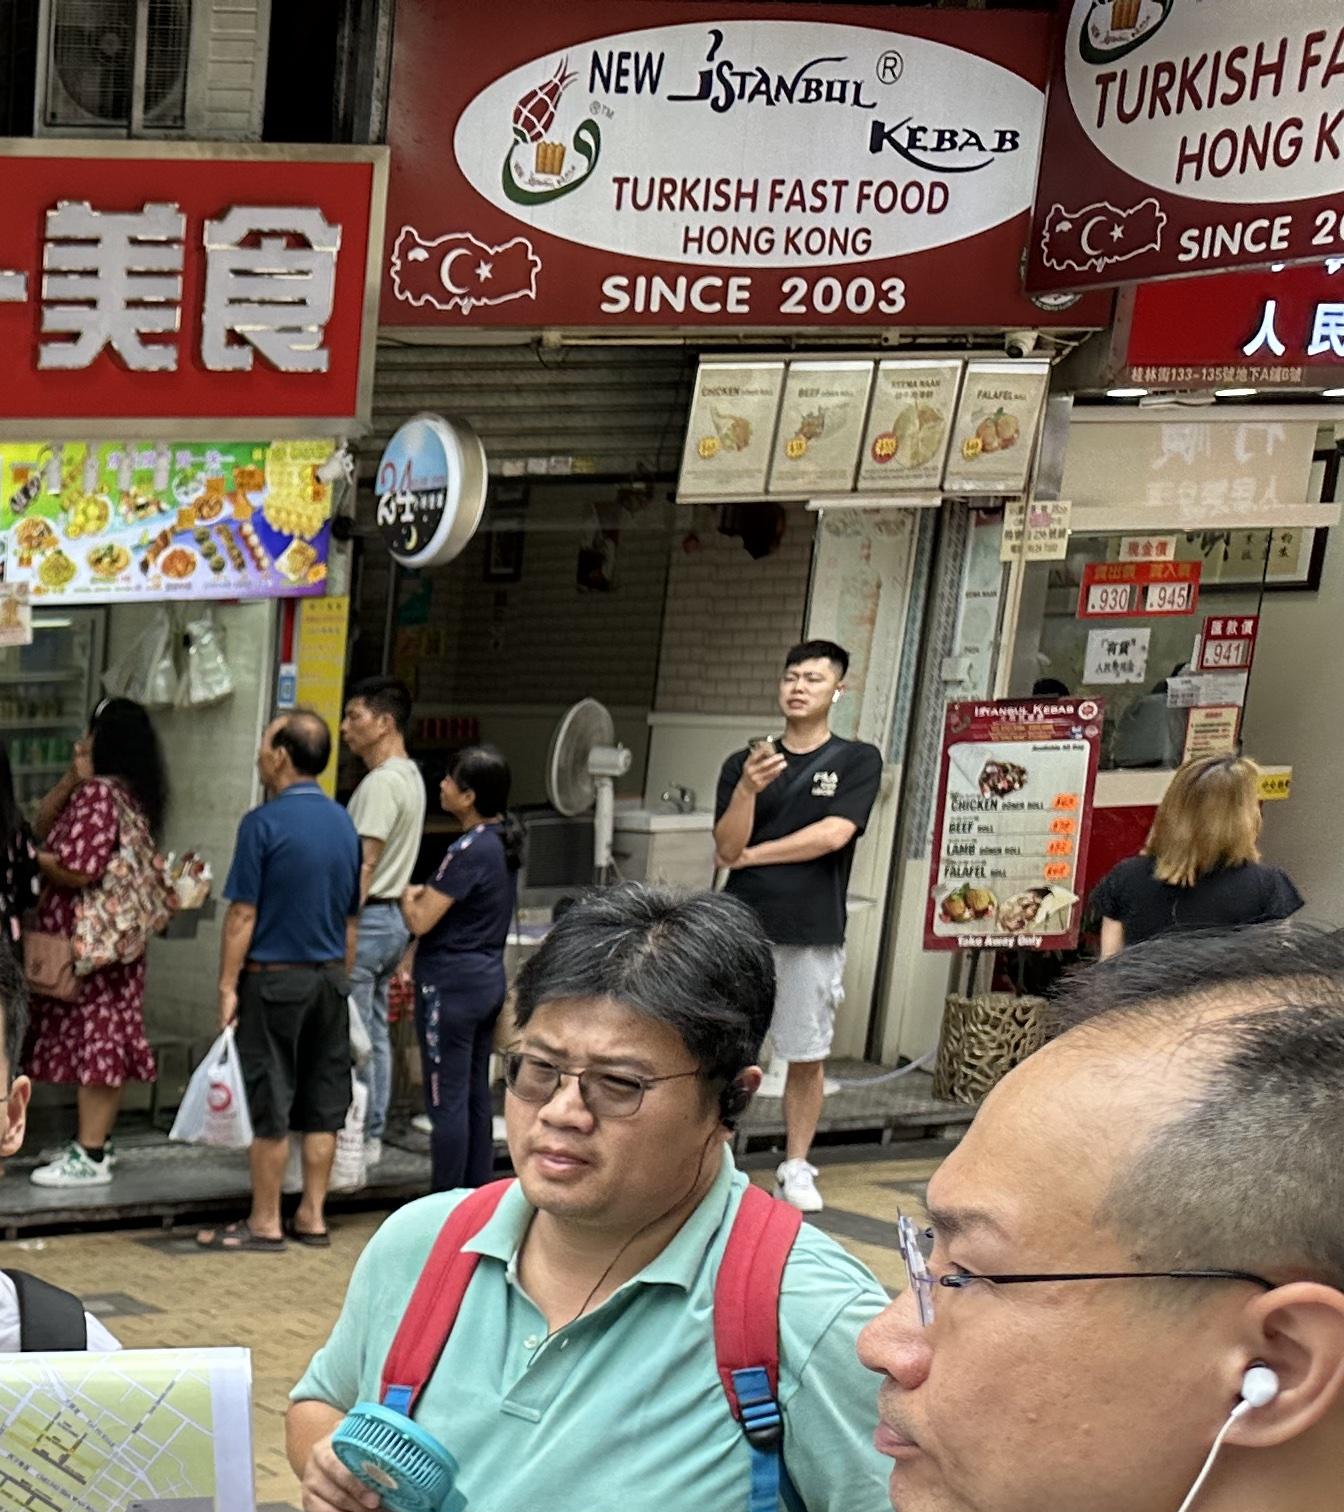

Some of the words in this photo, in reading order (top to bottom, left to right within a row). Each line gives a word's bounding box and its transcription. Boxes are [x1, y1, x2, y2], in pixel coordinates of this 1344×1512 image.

[589, 50, 664, 95] NEW
[1096, 38, 1288, 129] TURKISH
[869, 116, 1021, 173] KEBAB
[1175, 117, 1303, 184] HONG
[612, 176, 759, 213] TURKISH
[768, 178, 848, 213] FAST
[856, 180, 950, 215] FOOD
[682, 226, 775, 254] HONG
[783, 227, 872, 256] KONG
[1177, 215, 1292, 262] SINCE
[1312, 210, 1344, 247] 2
[600, 276, 751, 313] SINCE
[779, 277, 906, 314] 2003
[951, 799, 998, 811] CHICKEN
[946, 844, 976, 855] LAMB
[944, 866, 986, 878] FALAFEL
